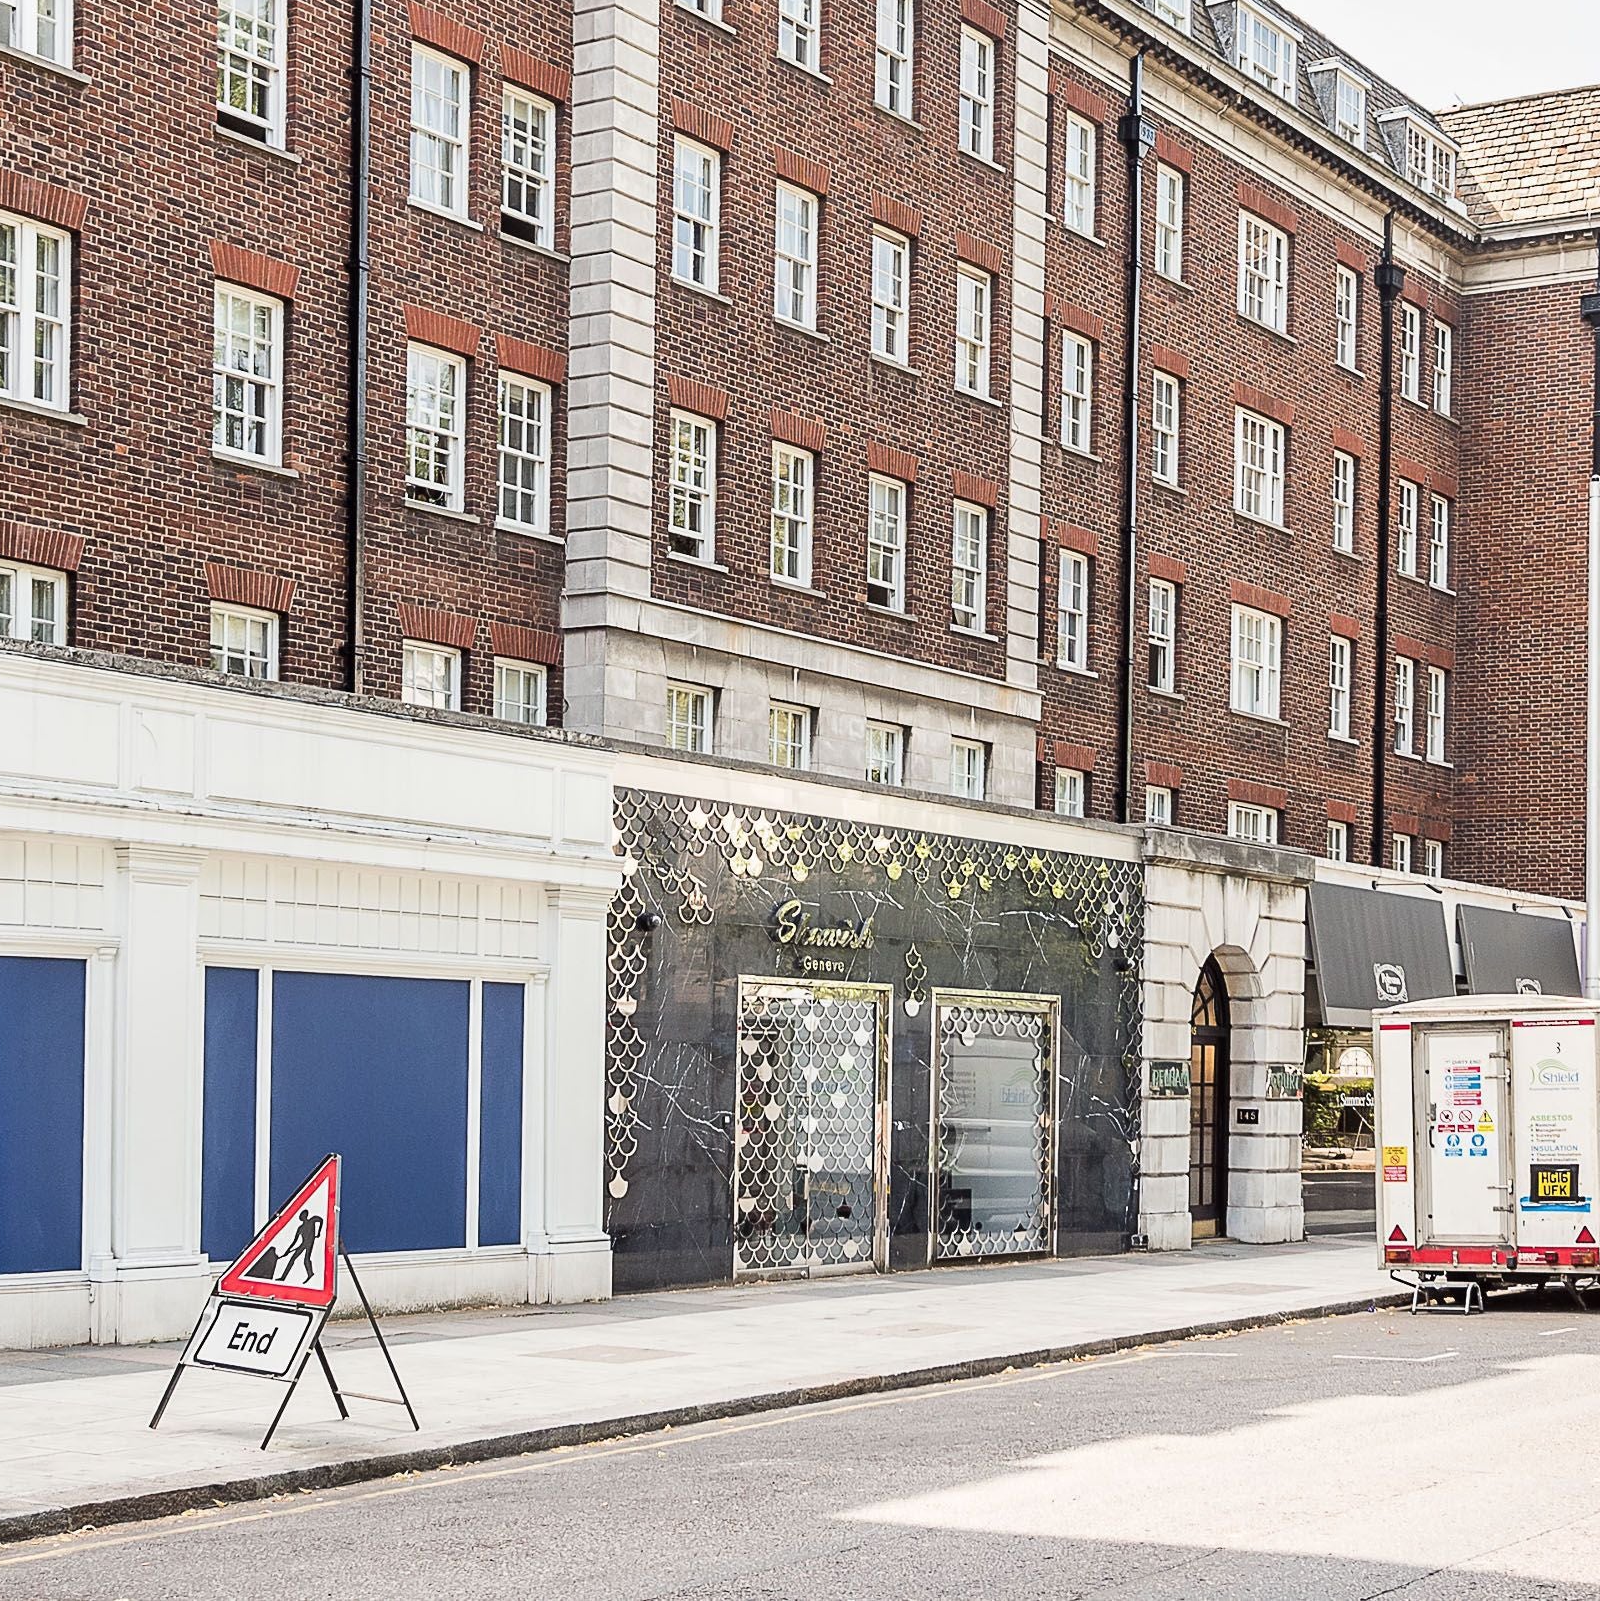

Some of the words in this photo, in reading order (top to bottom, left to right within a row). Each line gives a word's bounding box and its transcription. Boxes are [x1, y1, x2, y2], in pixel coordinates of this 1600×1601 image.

[803, 956, 845, 973] Geneve
[1542, 1072, 1579, 1083] Shield
[1239, 1110, 1256, 1122] 145
[1541, 1171, 1569, 1183] HG16
[1543, 1185, 1568, 1195] UFK
[227, 1322, 279, 1354] End
